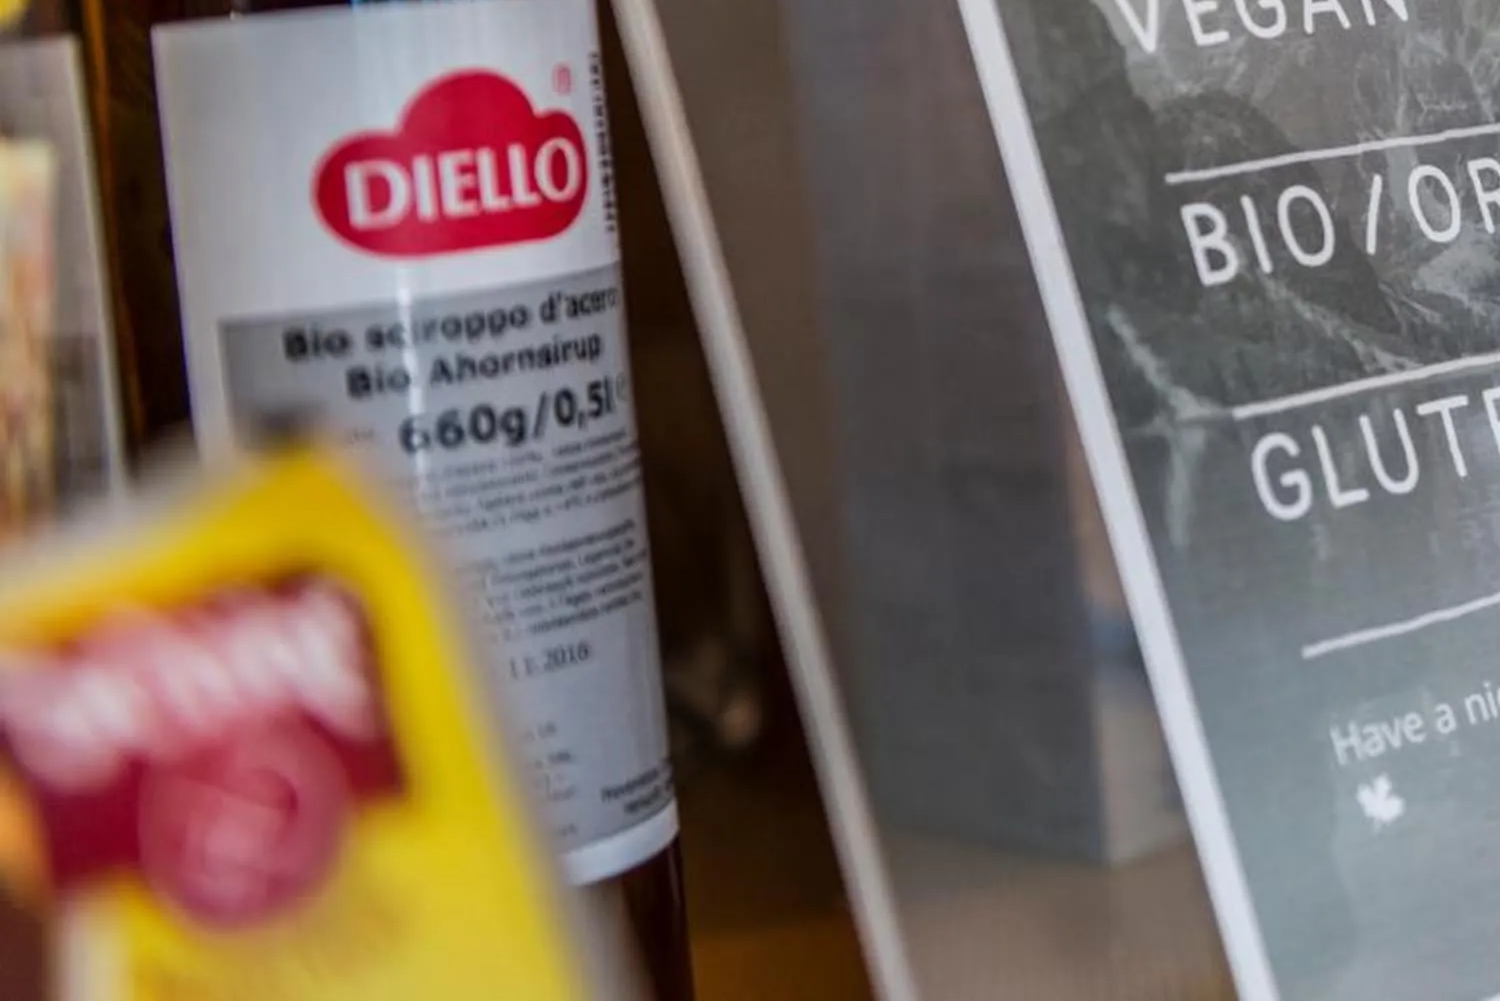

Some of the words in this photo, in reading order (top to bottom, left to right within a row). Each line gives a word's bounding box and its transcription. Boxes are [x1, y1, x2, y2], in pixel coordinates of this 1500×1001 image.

[343, 135, 581, 231] DIELLO
[283, 323, 351, 364] Bio
[366, 303, 528, 350] sciroppo
[346, 360, 412, 399] Bio
[430, 332, 603, 386] Ahornsirup
[1329, 711, 1426, 766] Have
[1435, 703, 1456, 735] a
